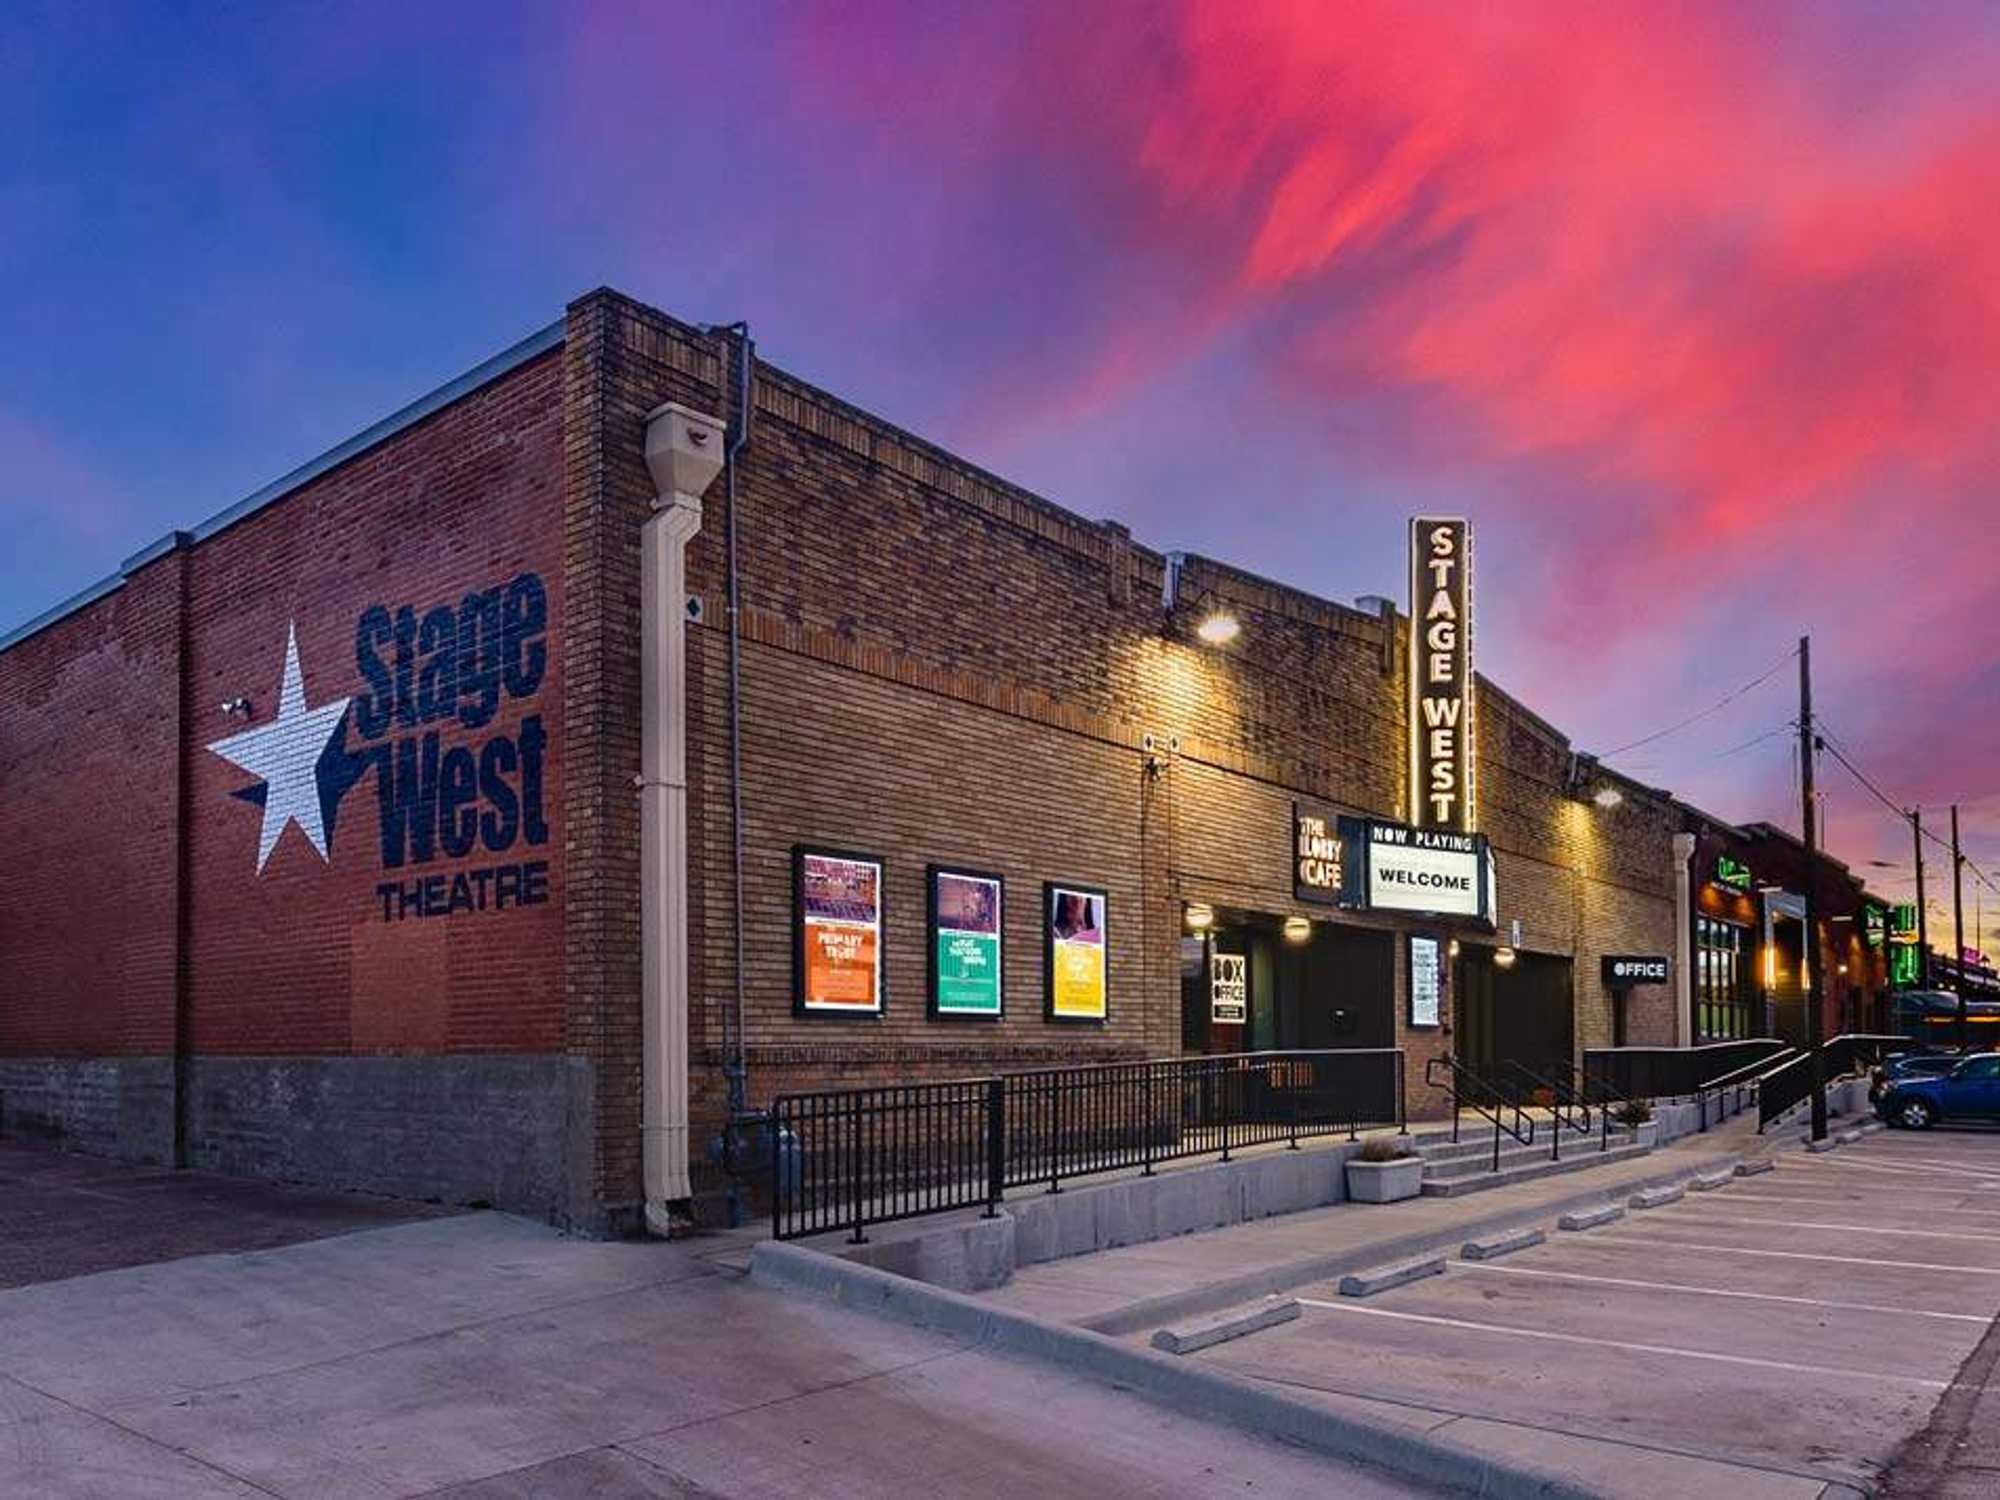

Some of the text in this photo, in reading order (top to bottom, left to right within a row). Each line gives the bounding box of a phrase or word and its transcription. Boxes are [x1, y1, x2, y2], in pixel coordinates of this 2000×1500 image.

[352, 572, 548, 740] Stage
[1422, 526, 1461, 823] STAGE WEST
[372, 714, 549, 869] West
[1299, 816, 1326, 837] THE
[1373, 827, 1473, 851] NOW PLAYING
[375, 860, 549, 923] THEATRE
[1378, 868, 1471, 891] WELCOME
[1214, 958, 1243, 983] BOX
[1614, 962, 1666, 977] OFFICE
[1214, 984, 1244, 1001] OFFICE
